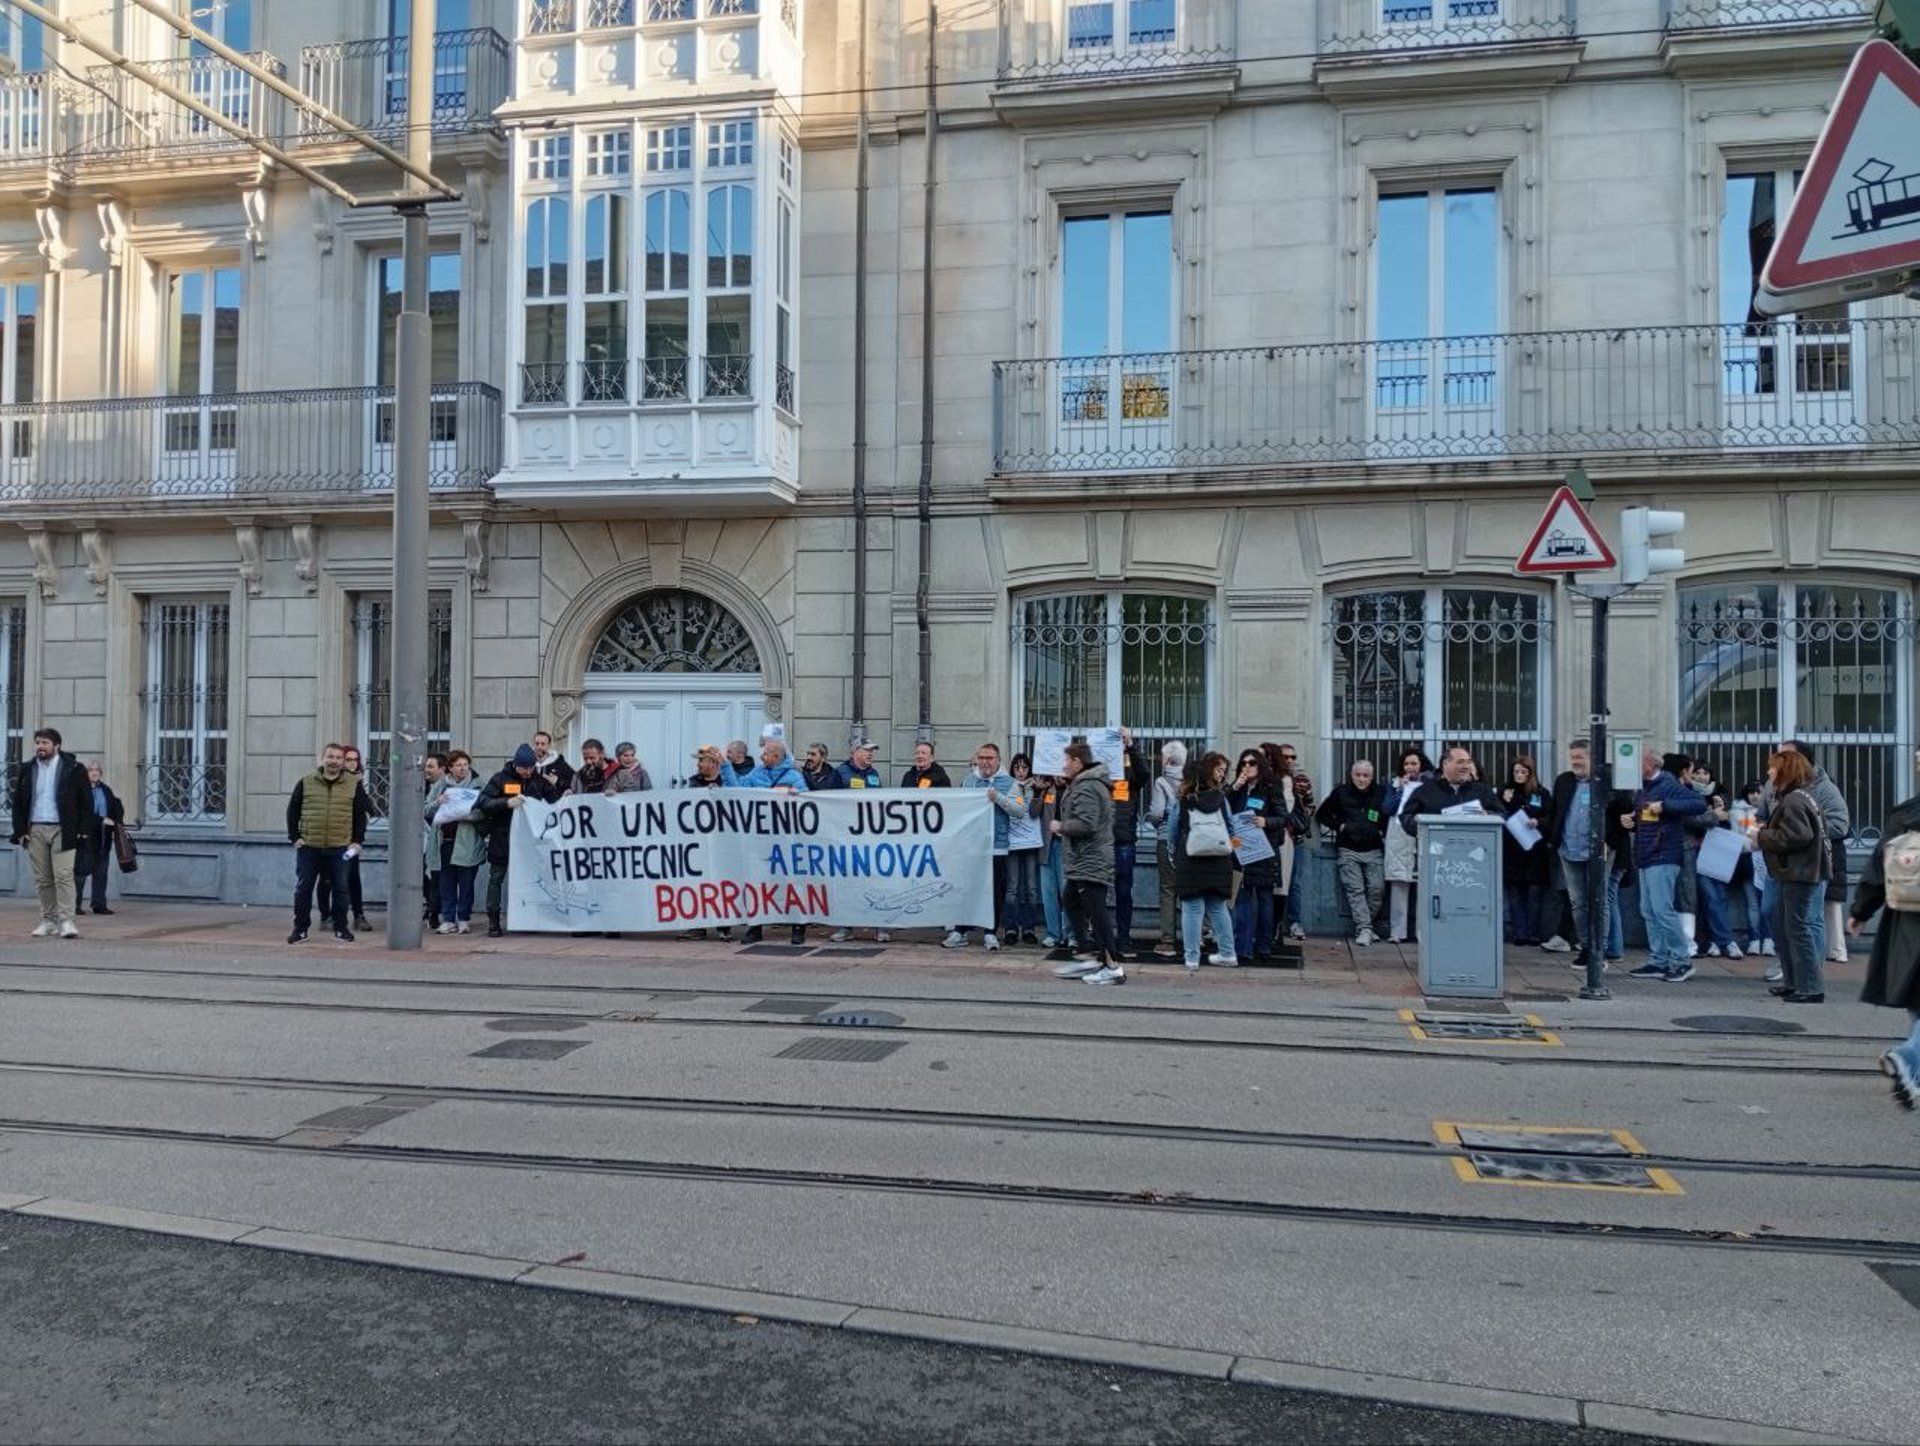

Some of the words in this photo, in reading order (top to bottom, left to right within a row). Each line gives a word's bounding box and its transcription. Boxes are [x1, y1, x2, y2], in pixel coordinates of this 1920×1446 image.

[620, 803, 667, 838] UN
[677, 799, 820, 835] CONVENIO
[848, 800, 945, 836] JUSTO
[550, 842, 703, 882] FIBERTECNIC
[769, 842, 942, 879] AERNNOVA
[655, 880, 830, 923] BORROKAN
